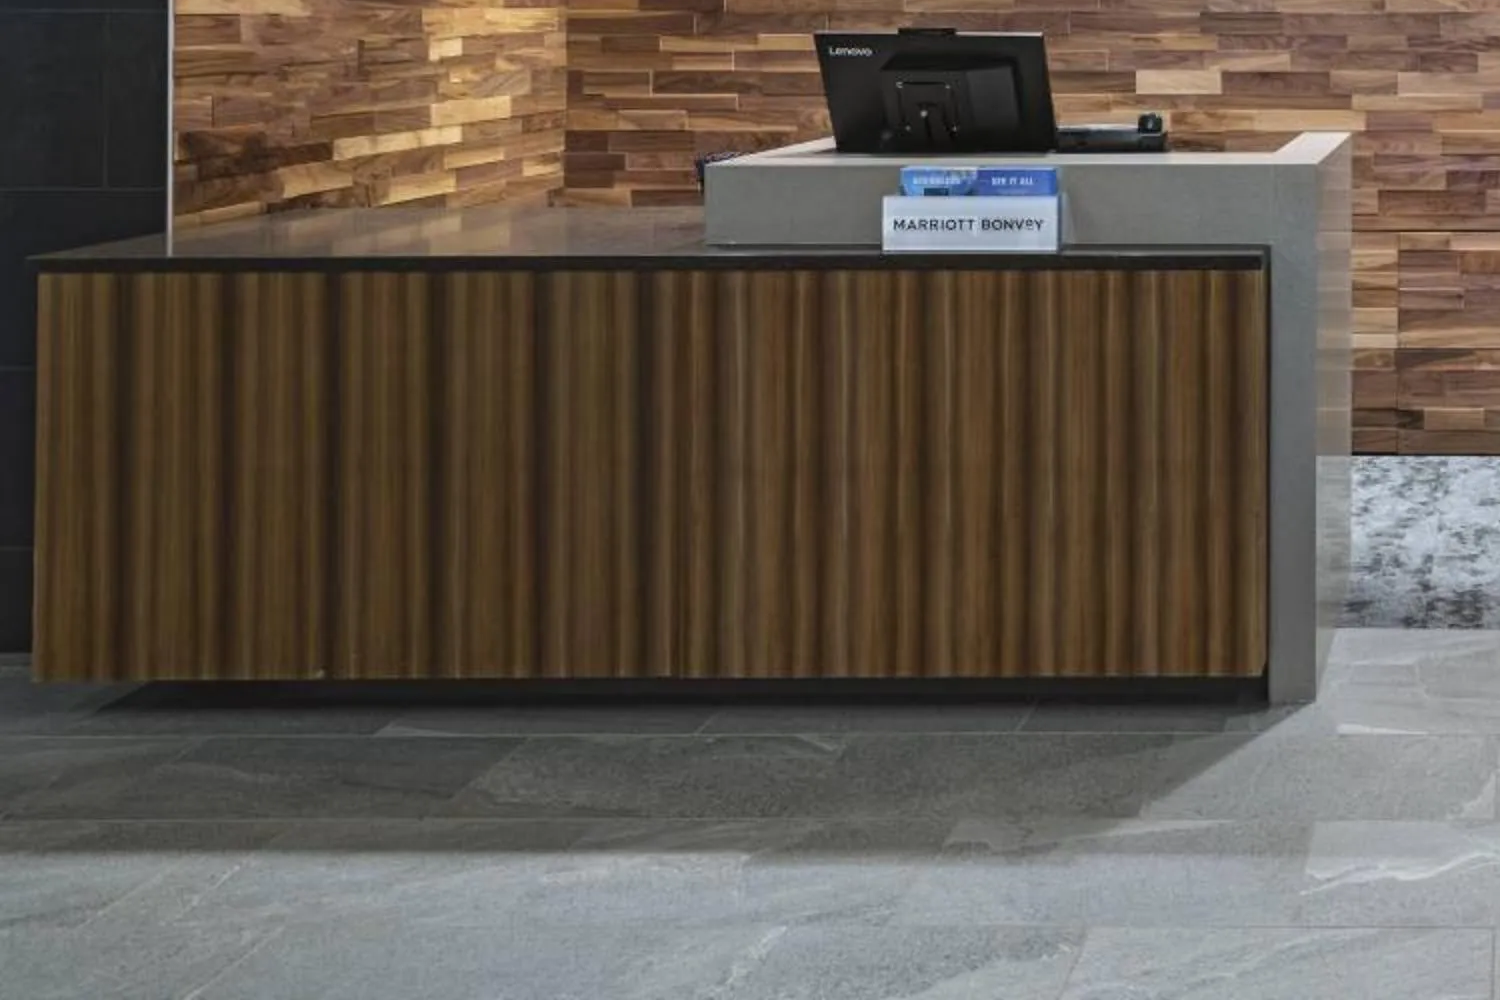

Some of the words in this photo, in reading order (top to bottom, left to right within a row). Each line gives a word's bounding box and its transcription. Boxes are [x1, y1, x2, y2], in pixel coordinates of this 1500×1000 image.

[829, 46, 873, 57] Lenovo
[893, 218, 975, 231] MARRIOTT
[981, 218, 1044, 231] BONVOY
